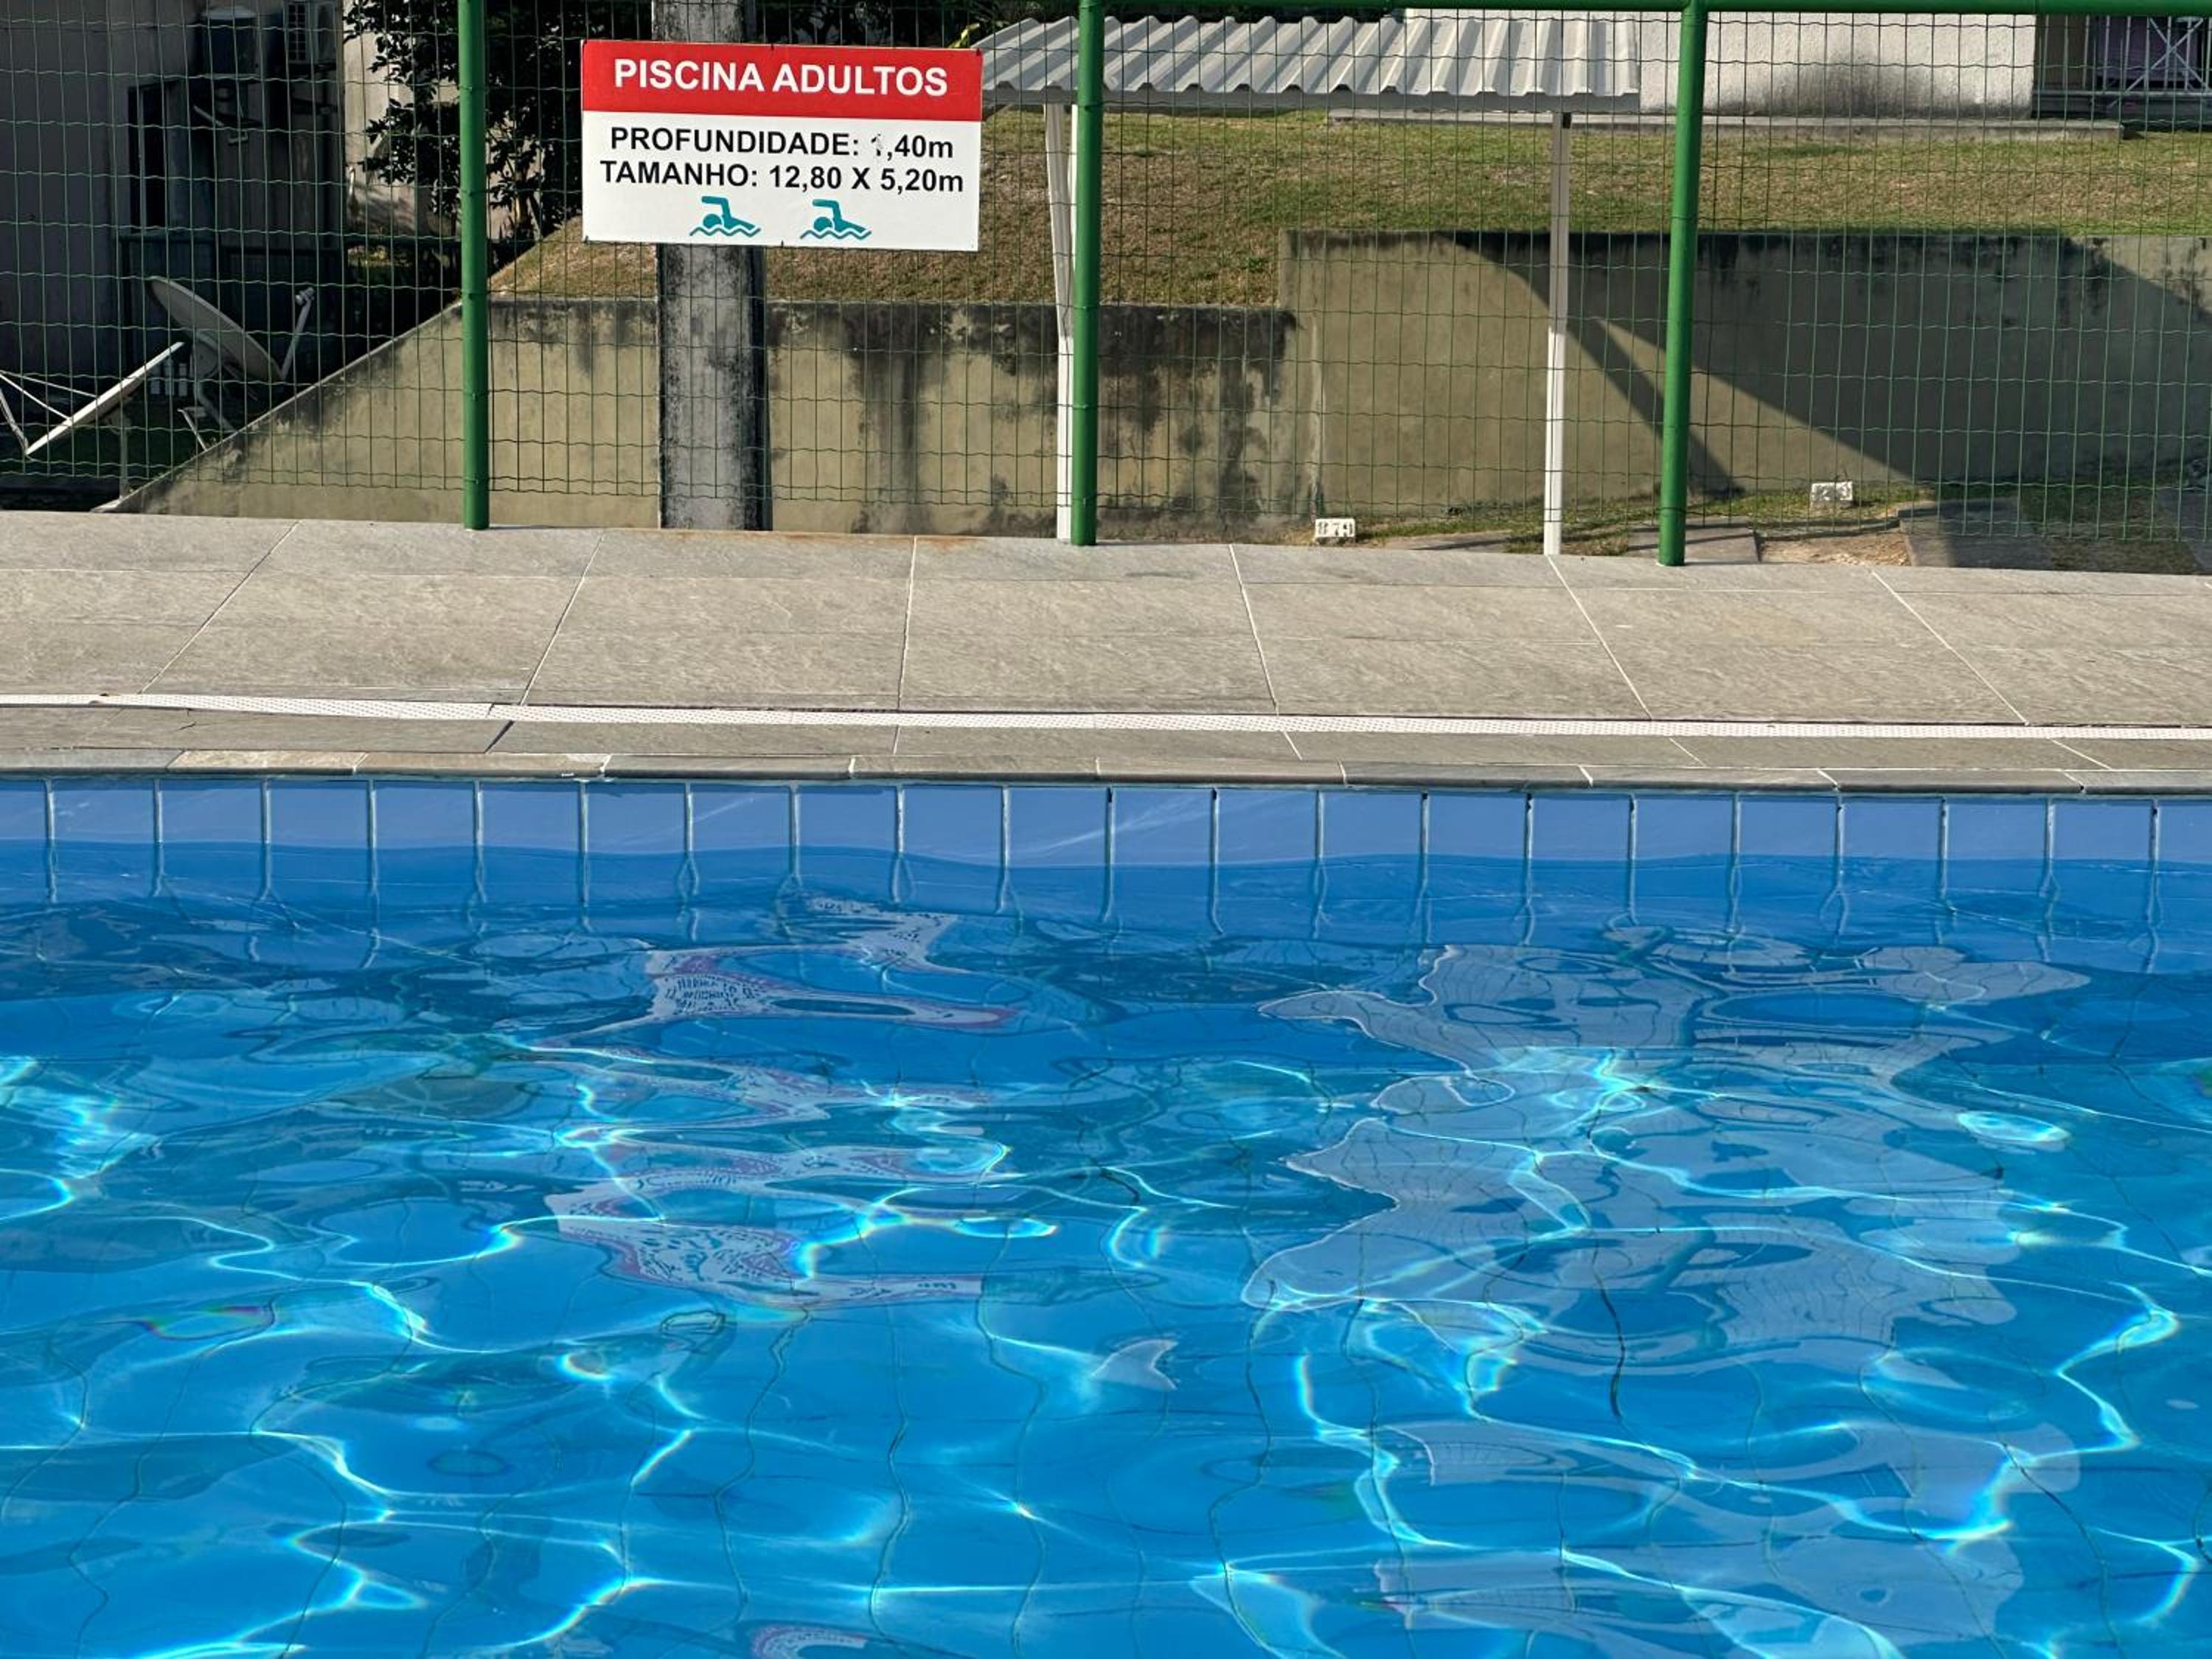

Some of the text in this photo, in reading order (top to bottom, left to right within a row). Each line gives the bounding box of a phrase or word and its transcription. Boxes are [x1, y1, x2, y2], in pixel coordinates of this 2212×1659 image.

[613, 58, 948, 97] PISCINA ADULTOS
[611, 127, 859, 157] PROFUNDIDADE:
[599, 160, 964, 195] TAMANHO: 12,80 X 5,20m
